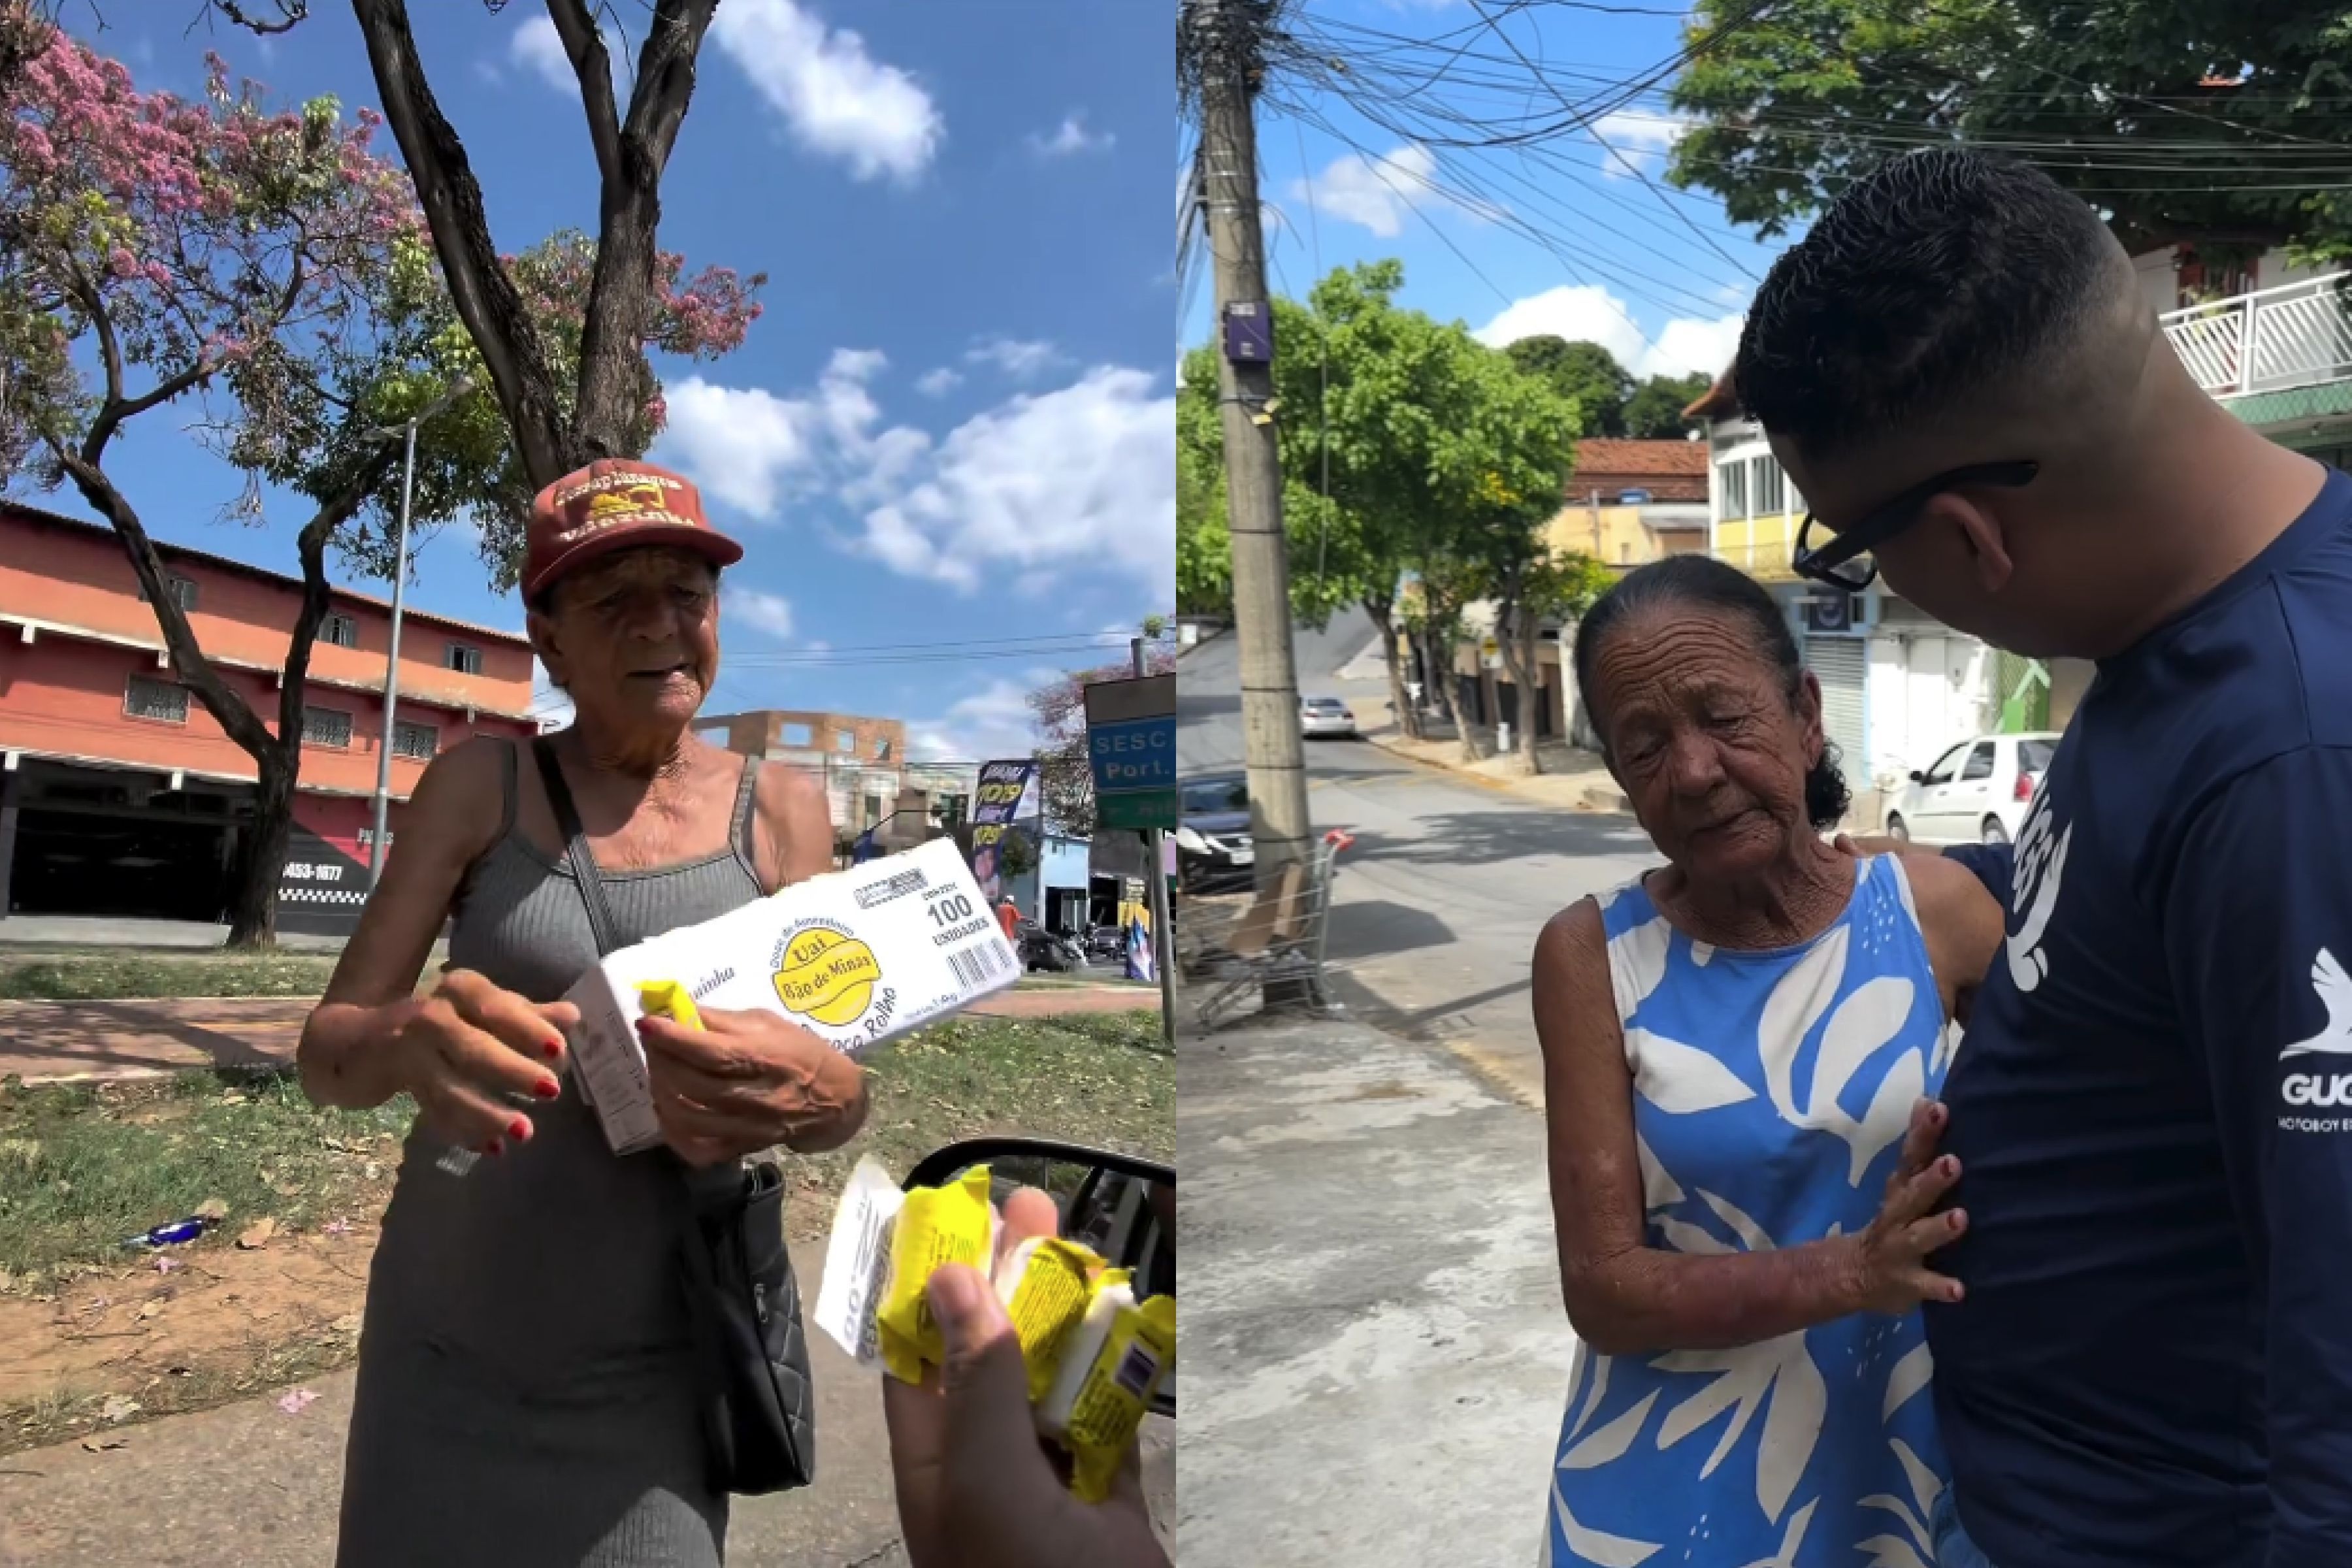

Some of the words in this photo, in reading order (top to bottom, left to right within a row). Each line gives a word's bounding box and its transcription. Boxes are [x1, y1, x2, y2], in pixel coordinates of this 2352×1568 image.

[1096, 730, 1166, 753] SESC
[1105, 760, 1170, 779] Port.
[928, 894, 973, 927] 100
[932, 916, 990, 945] UNIDADES
[792, 934, 826, 962] Uai
[814, 973, 829, 988] de
[826, 956, 871, 977] Minas
